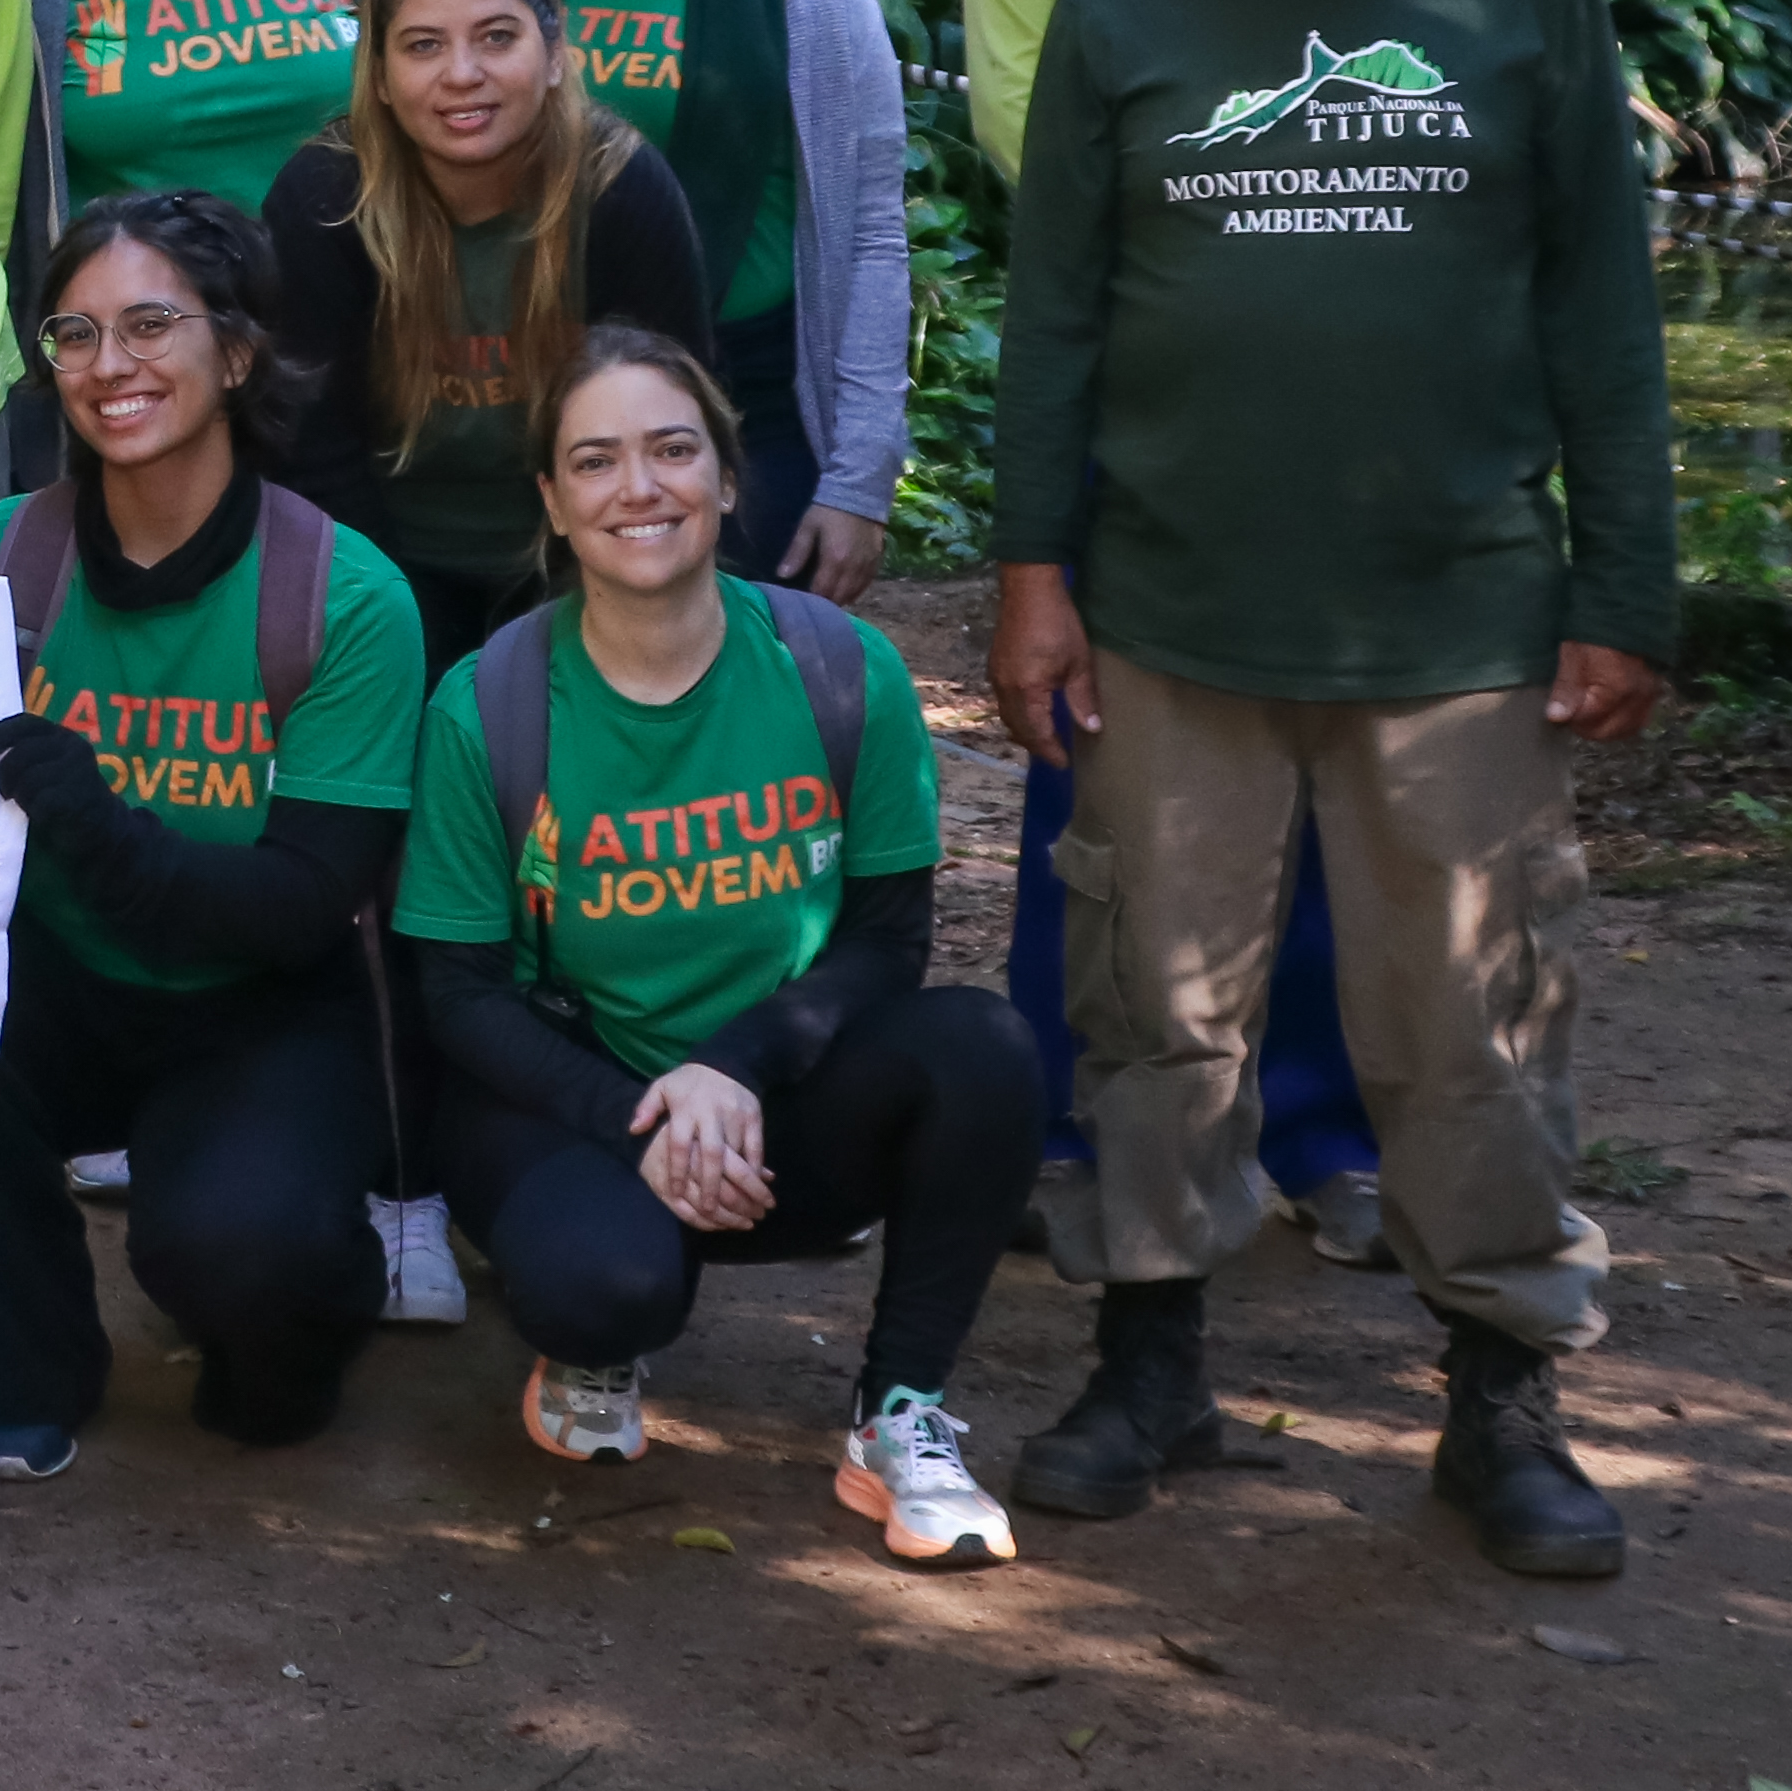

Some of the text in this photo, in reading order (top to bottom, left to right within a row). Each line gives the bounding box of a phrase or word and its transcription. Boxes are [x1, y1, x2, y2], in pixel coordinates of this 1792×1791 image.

[149, 19, 337, 77] JOVEM
[577, 7, 685, 51] TITU
[1303, 112, 1473, 143] TIJUCA
[1163, 167, 1470, 202] MONITORAMENTO
[1222, 206, 1414, 235] AMBIENTAL
[59, 687, 276, 755] ATITUD
[96, 753, 255, 808] OVEM
[580, 843, 803, 921] JOVEM
